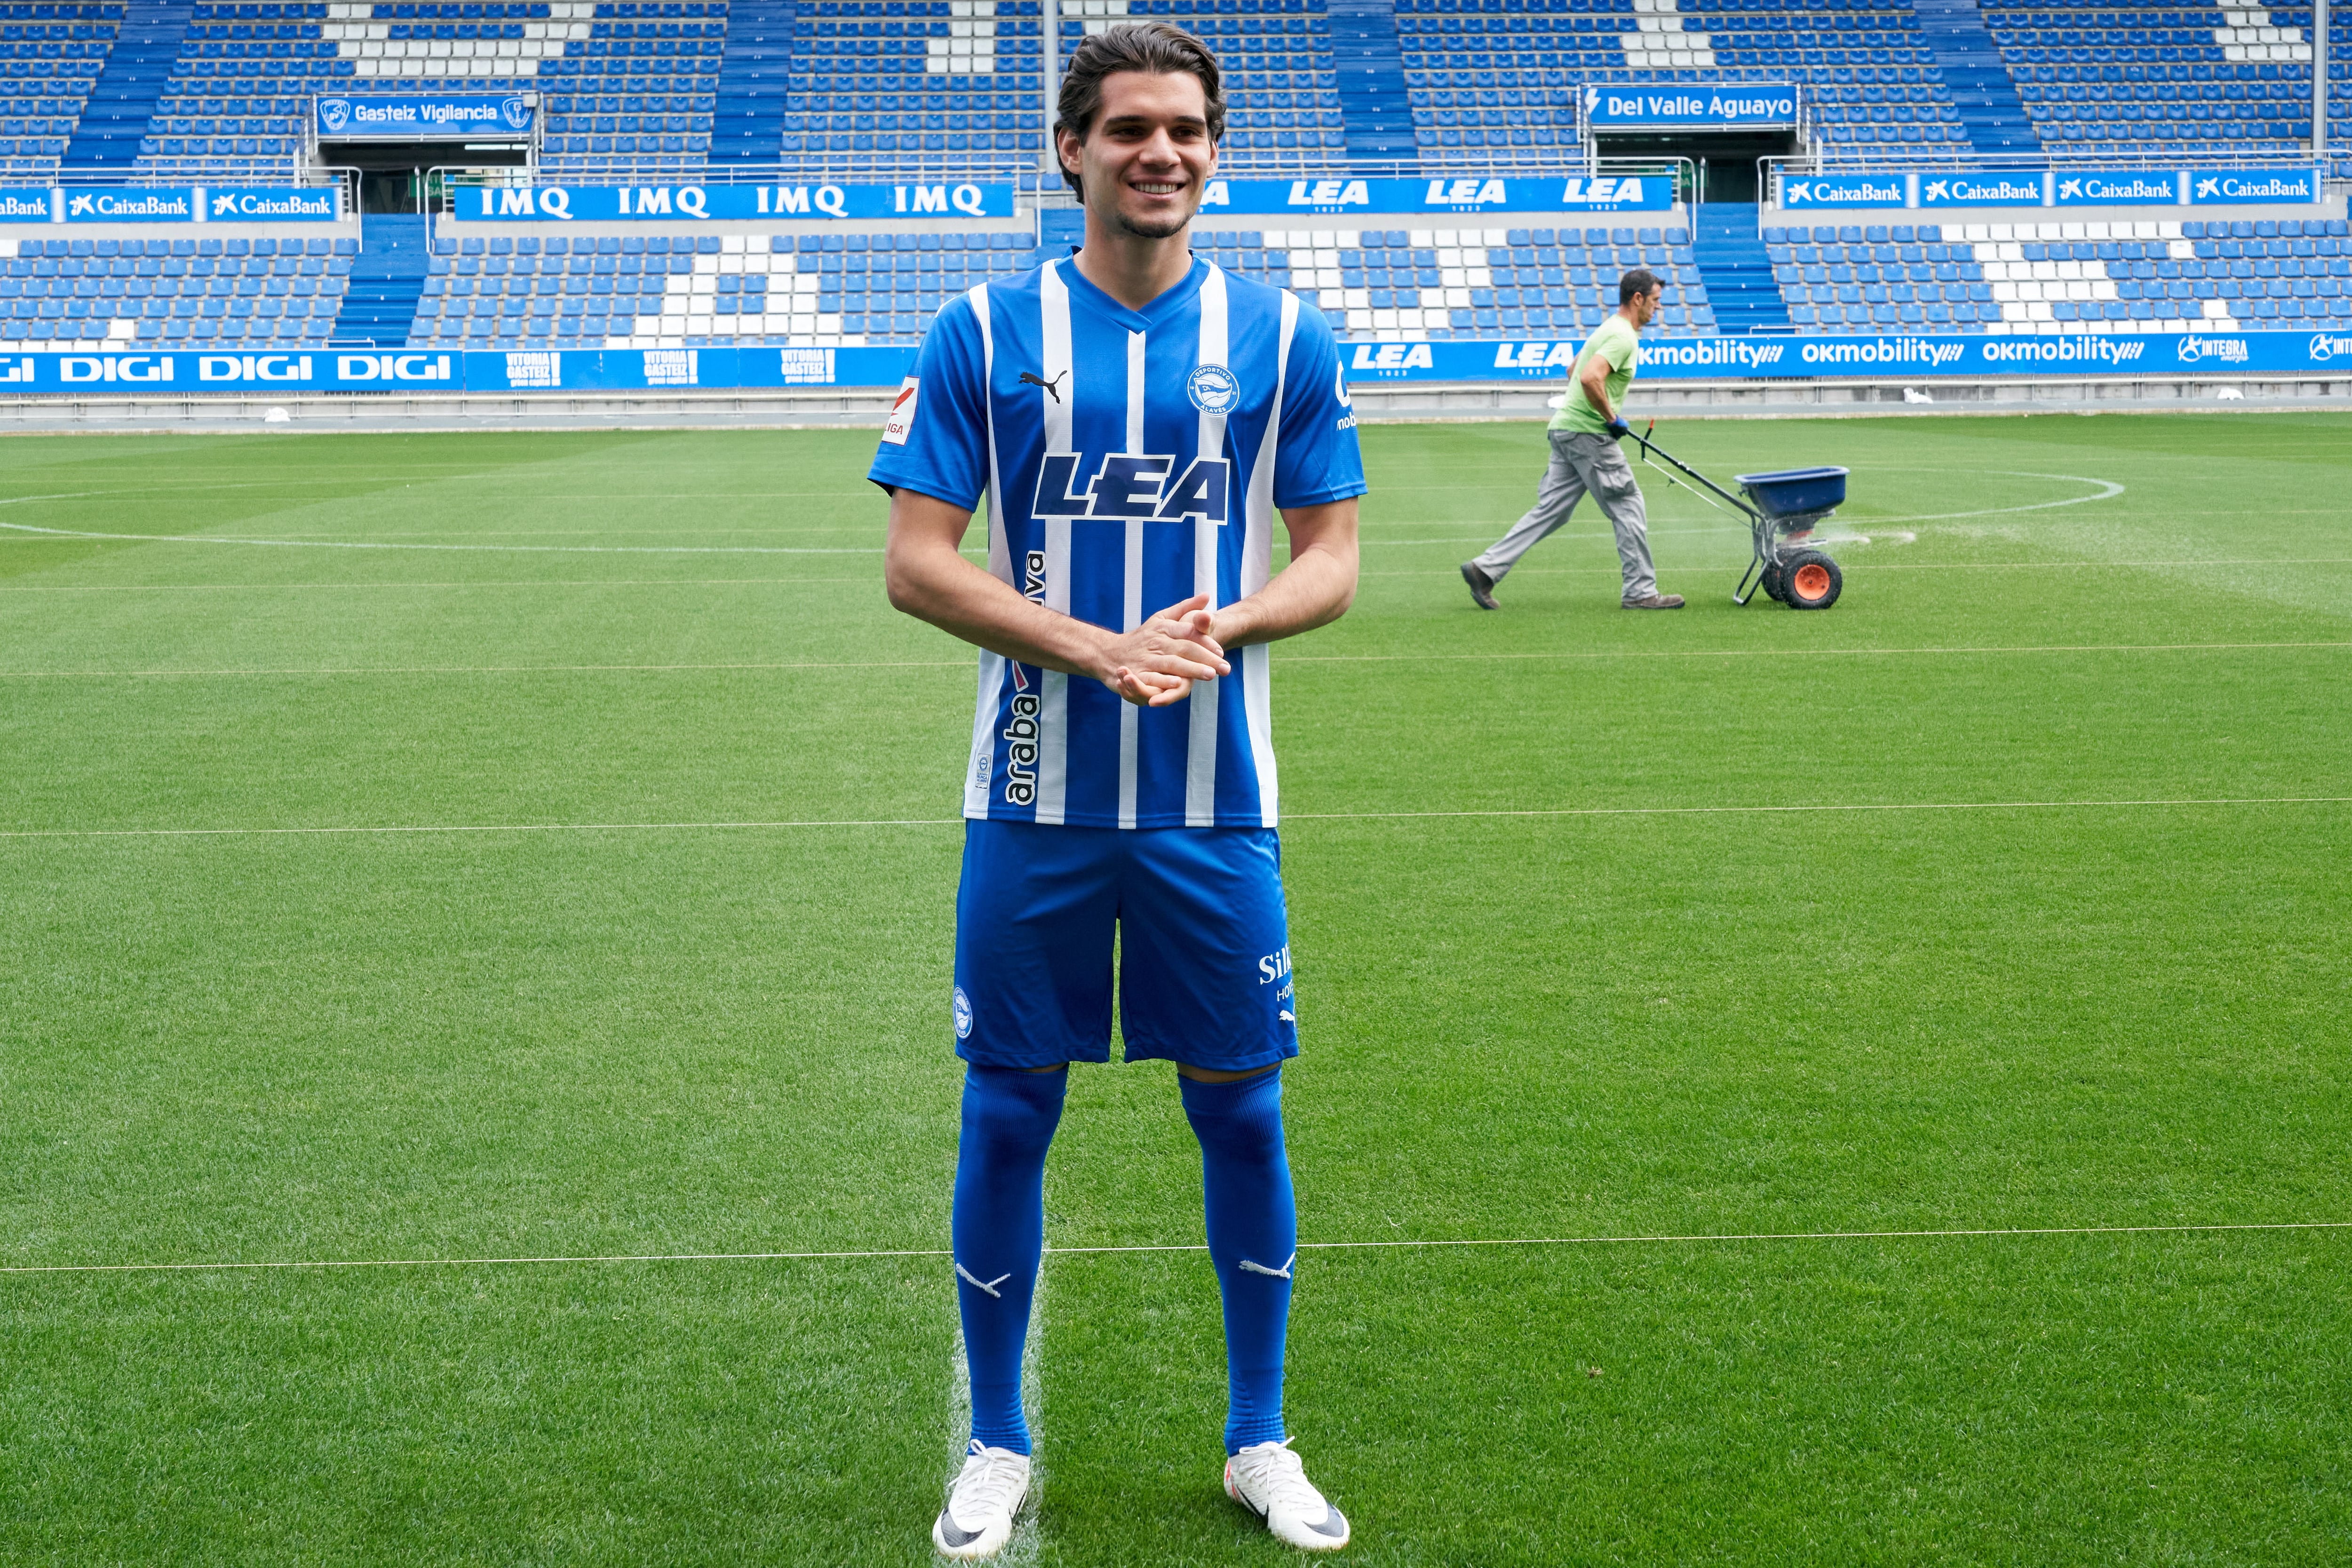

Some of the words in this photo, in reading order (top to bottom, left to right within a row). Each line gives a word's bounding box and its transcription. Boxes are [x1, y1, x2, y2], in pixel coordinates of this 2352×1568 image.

[355, 105, 416, 121] Gasteiz
[421, 104, 497, 124] Vigilancia
[1608, 96, 1643, 116] Del
[1648, 96, 1703, 115] Valle
[1708, 96, 1792, 119] Aguayo
[1287, 181, 1369, 205] LEA
[1425, 179, 1506, 204] LEA
[1563, 178, 1644, 203] LEA
[1814, 183, 1902, 201] CaixaBank
[1952, 181, 2039, 199] CaixaBank
[2085, 180, 2172, 198] CaixaBank
[2223, 179, 2309, 196] CaixaBank
[97, 196, 188, 215] CaixaBank
[240, 195, 331, 214] CaixaBank
[481, 188, 573, 219] IMQ
[618, 187, 710, 218] IMQ
[756, 187, 849, 218] IMQ
[894, 185, 986, 216] IMQ
[643, 350, 687, 363] VITORIA
[781, 349, 825, 362] VITORIA
[1351, 344, 1433, 369] LEA
[1494, 342, 1575, 368] LEA
[2202, 340, 2248, 356] INTEGRA
[199, 356, 312, 381] DIGI
[337, 355, 451, 380] DIGI
[506, 352, 549, 366] VITORIA
[781, 362, 825, 375] GASTEIZ
[60, 357, 174, 382] DIGI
[507, 366, 550, 379] GASTEIZ
[644, 363, 687, 376] GASTEIZ
[1195, 367, 1231, 381] DEPORTIVO
[1200, 404, 1226, 414] ALAVÉS
[885, 422, 904, 435] IGA
[1031, 452, 1231, 526] LEA
[1005, 695, 1038, 804] araba
